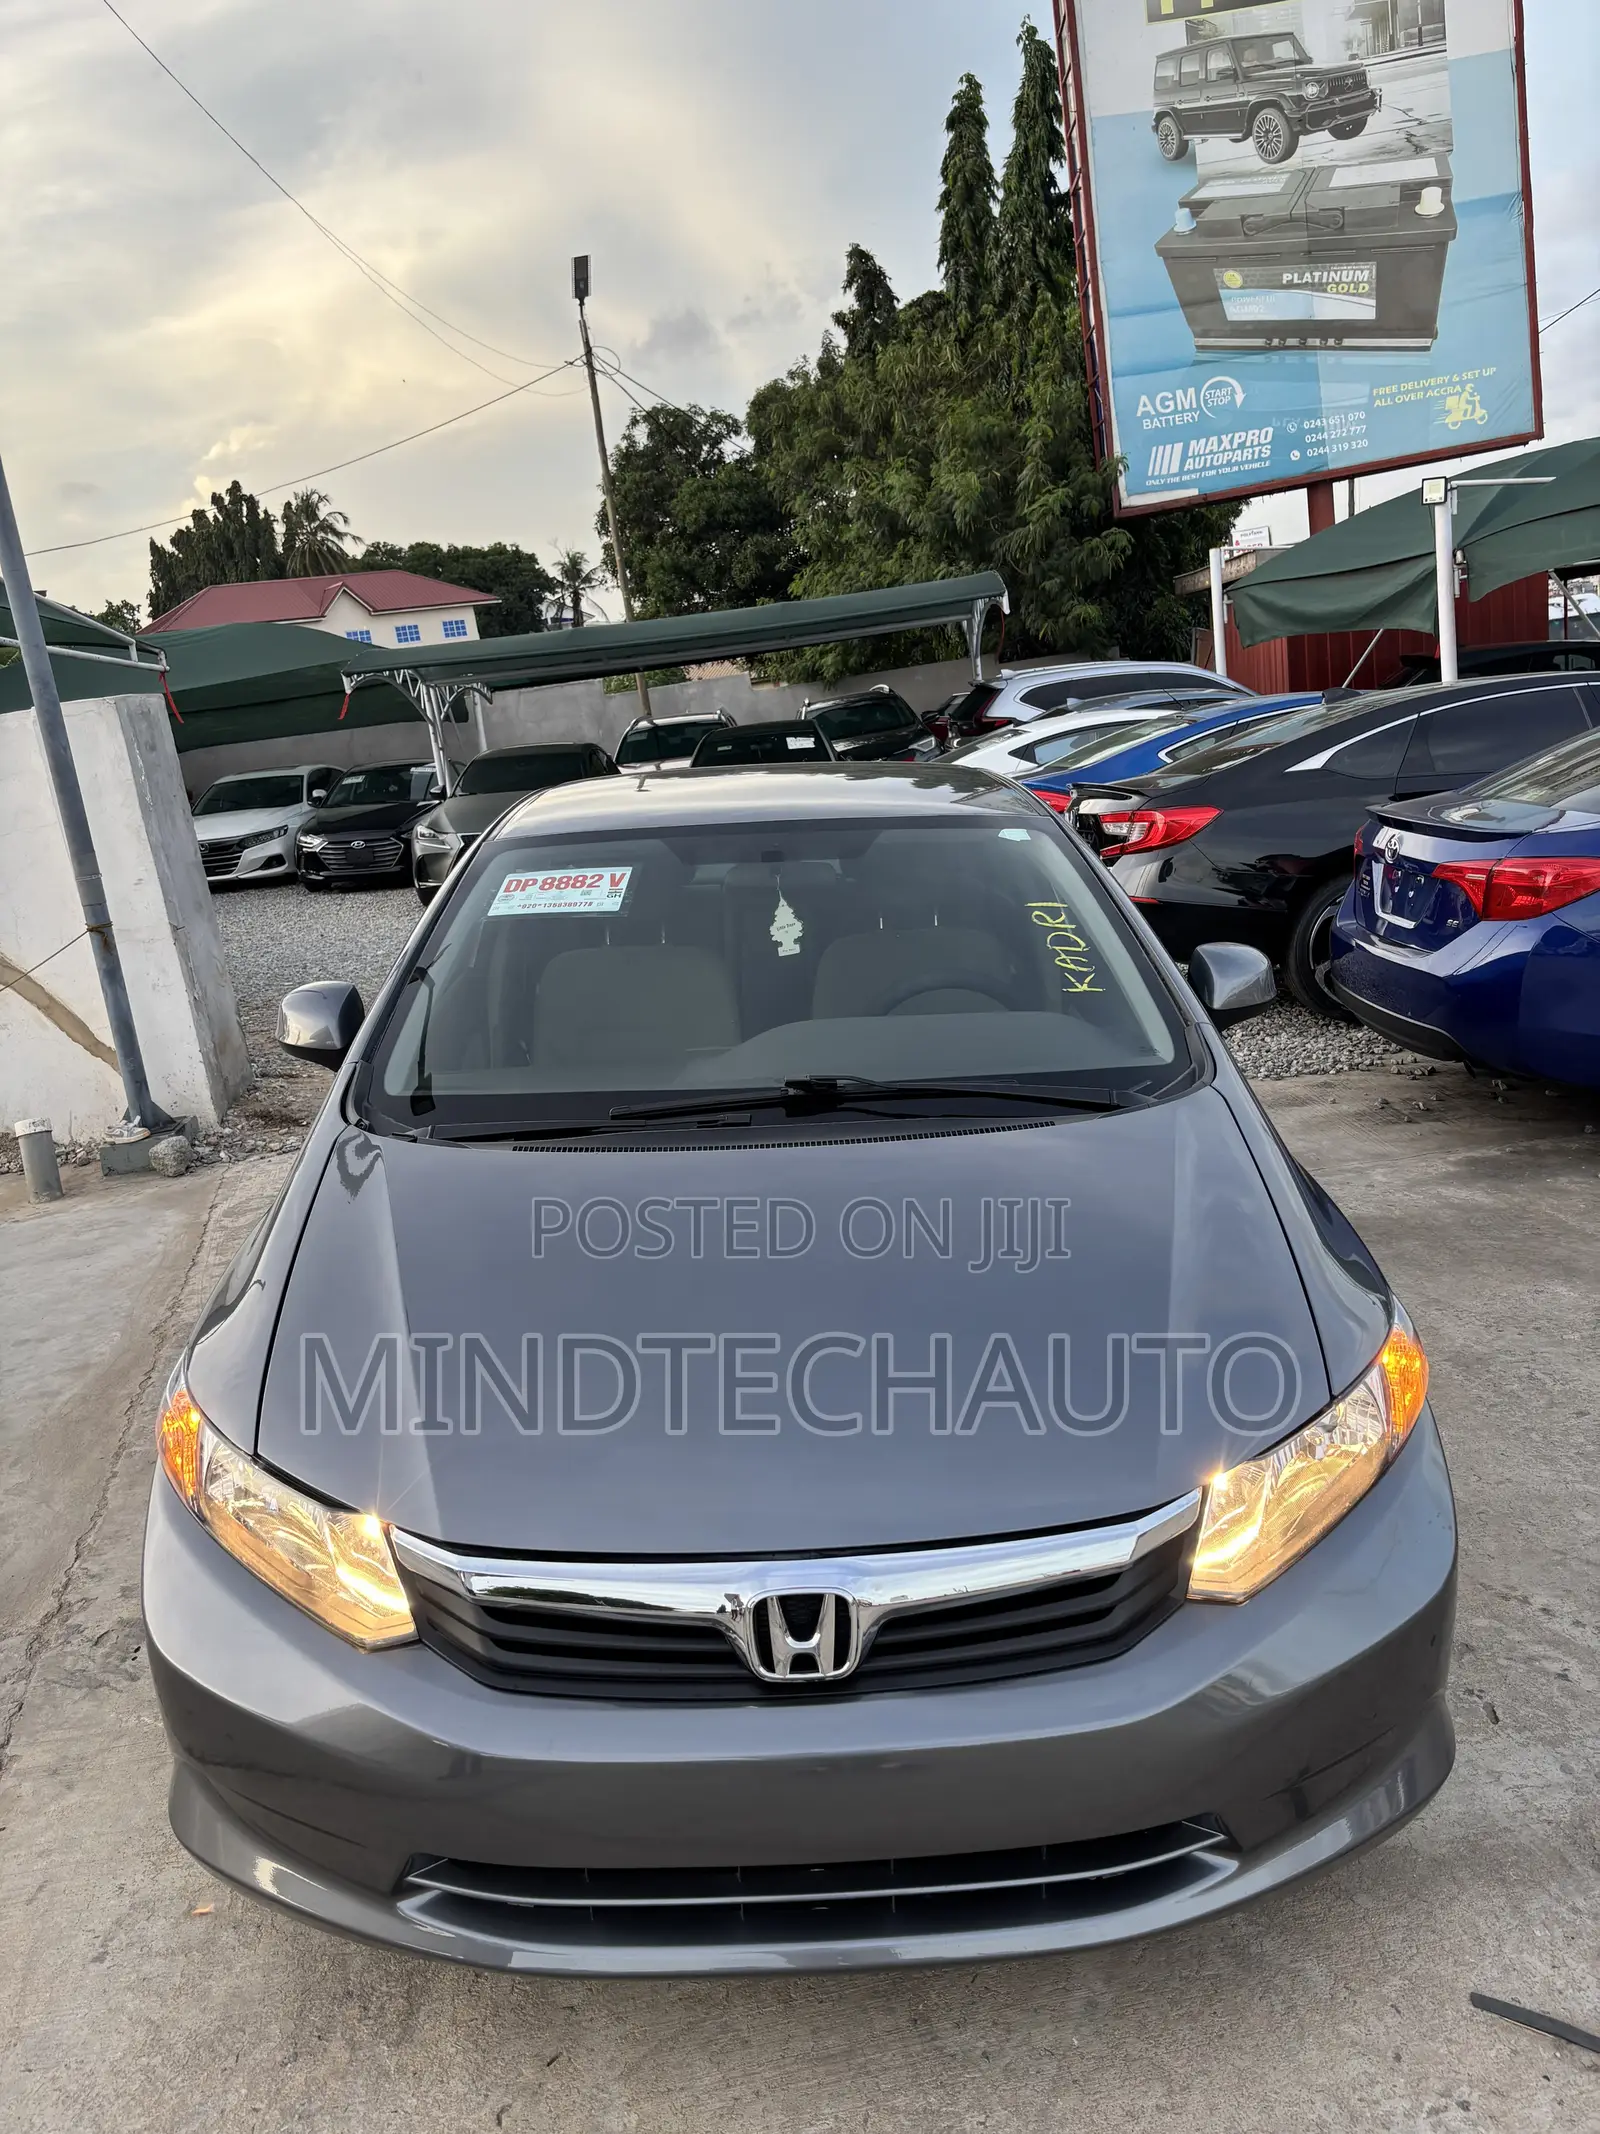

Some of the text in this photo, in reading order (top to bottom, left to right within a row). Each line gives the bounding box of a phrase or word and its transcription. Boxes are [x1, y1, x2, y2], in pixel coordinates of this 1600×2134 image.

[1282, 269, 1370, 285] PLATINUM
[1326, 283, 1370, 293] GOLD
[1372, 367, 1497, 396] FREE DELIVERY & SET UP
[1136, 387, 1197, 417] AGM
[1205, 386, 1233, 400] START
[1207, 395, 1231, 408] STOP
[1373, 385, 1462, 408] ALL OVER ACCRA
[1143, 411, 1200, 430] BATTERY
[1303, 418, 1327, 429] 0243
[1328, 414, 1345, 425] 651
[1347, 411, 1366, 421] 070
[1188, 427, 1274, 457] MAXPRO
[1305, 425, 1367, 443] 0244 272 777
[1306, 439, 1369, 457] 0244 319 320
[1183, 444, 1271, 471] AUTOPARTS
[1146, 460, 1271, 486] ONLY THE BEST FOR YOUR VEHICLE
[503, 872, 627, 893] DP 8882 V
[1445, 919, 1460, 928] SE
